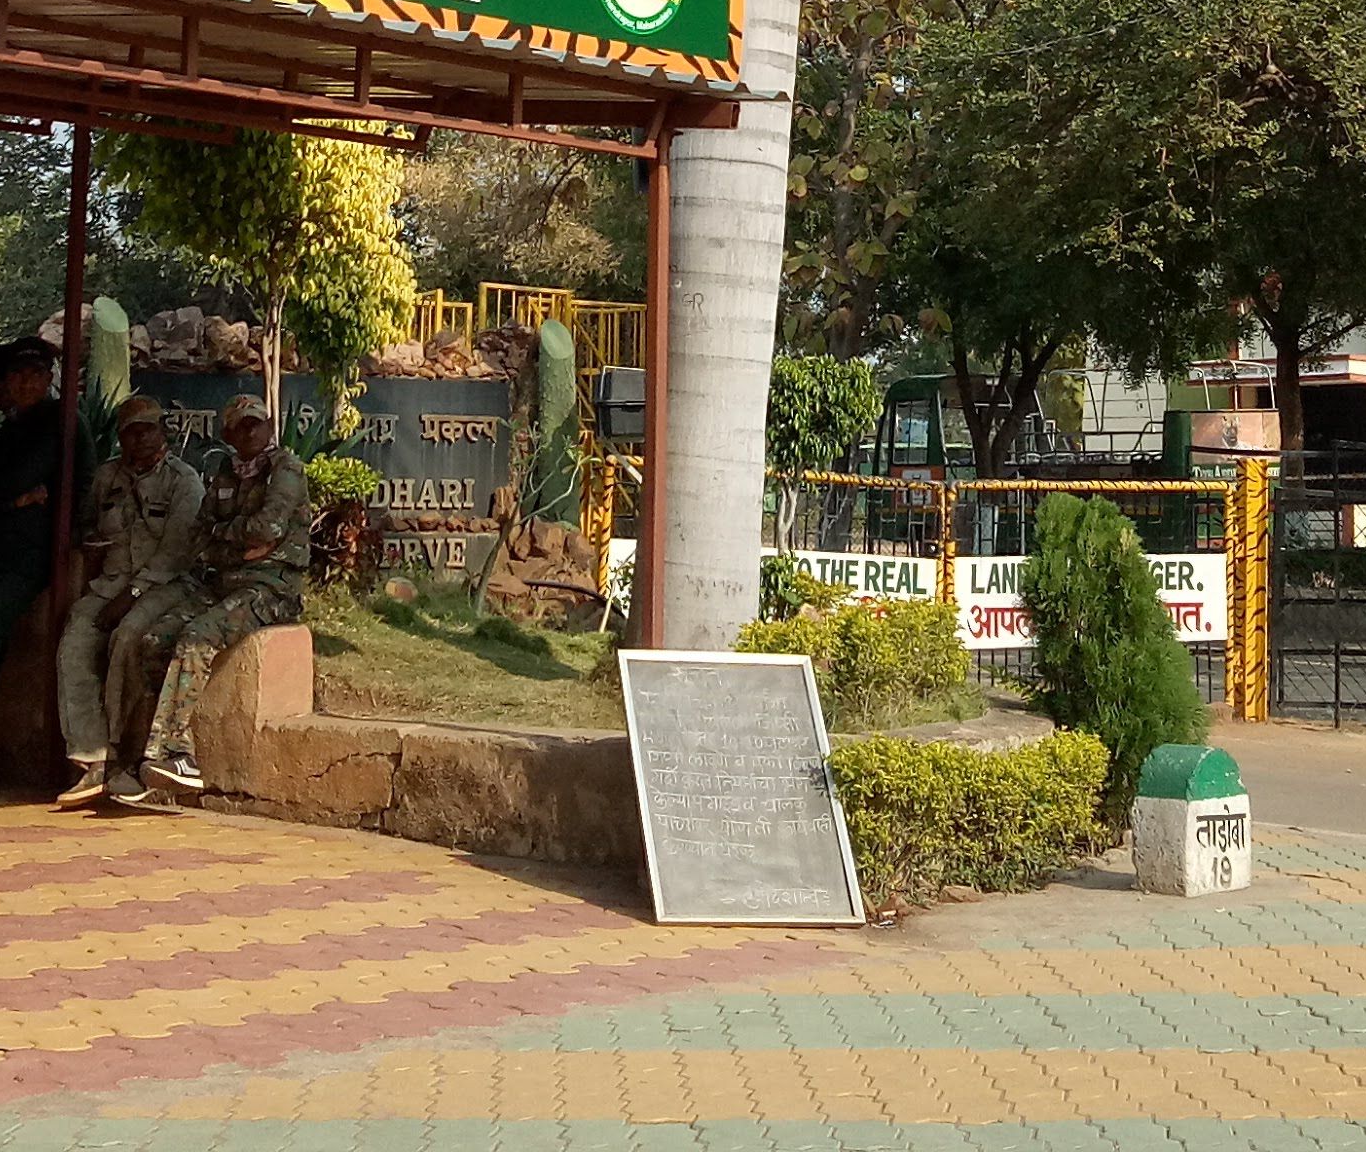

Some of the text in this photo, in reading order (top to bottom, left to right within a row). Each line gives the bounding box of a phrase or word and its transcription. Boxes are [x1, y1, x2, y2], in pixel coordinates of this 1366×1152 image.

[420, 413, 500, 446] प्रकल्प
[367, 478, 475, 509] DHARI
[379, 538, 467, 568] ERVE
[816, 558, 859, 591] THE
[864, 560, 927, 595] REAL
[1196, 804, 1247, 853] ताडोबा
[1212, 856, 1232, 888] 19
